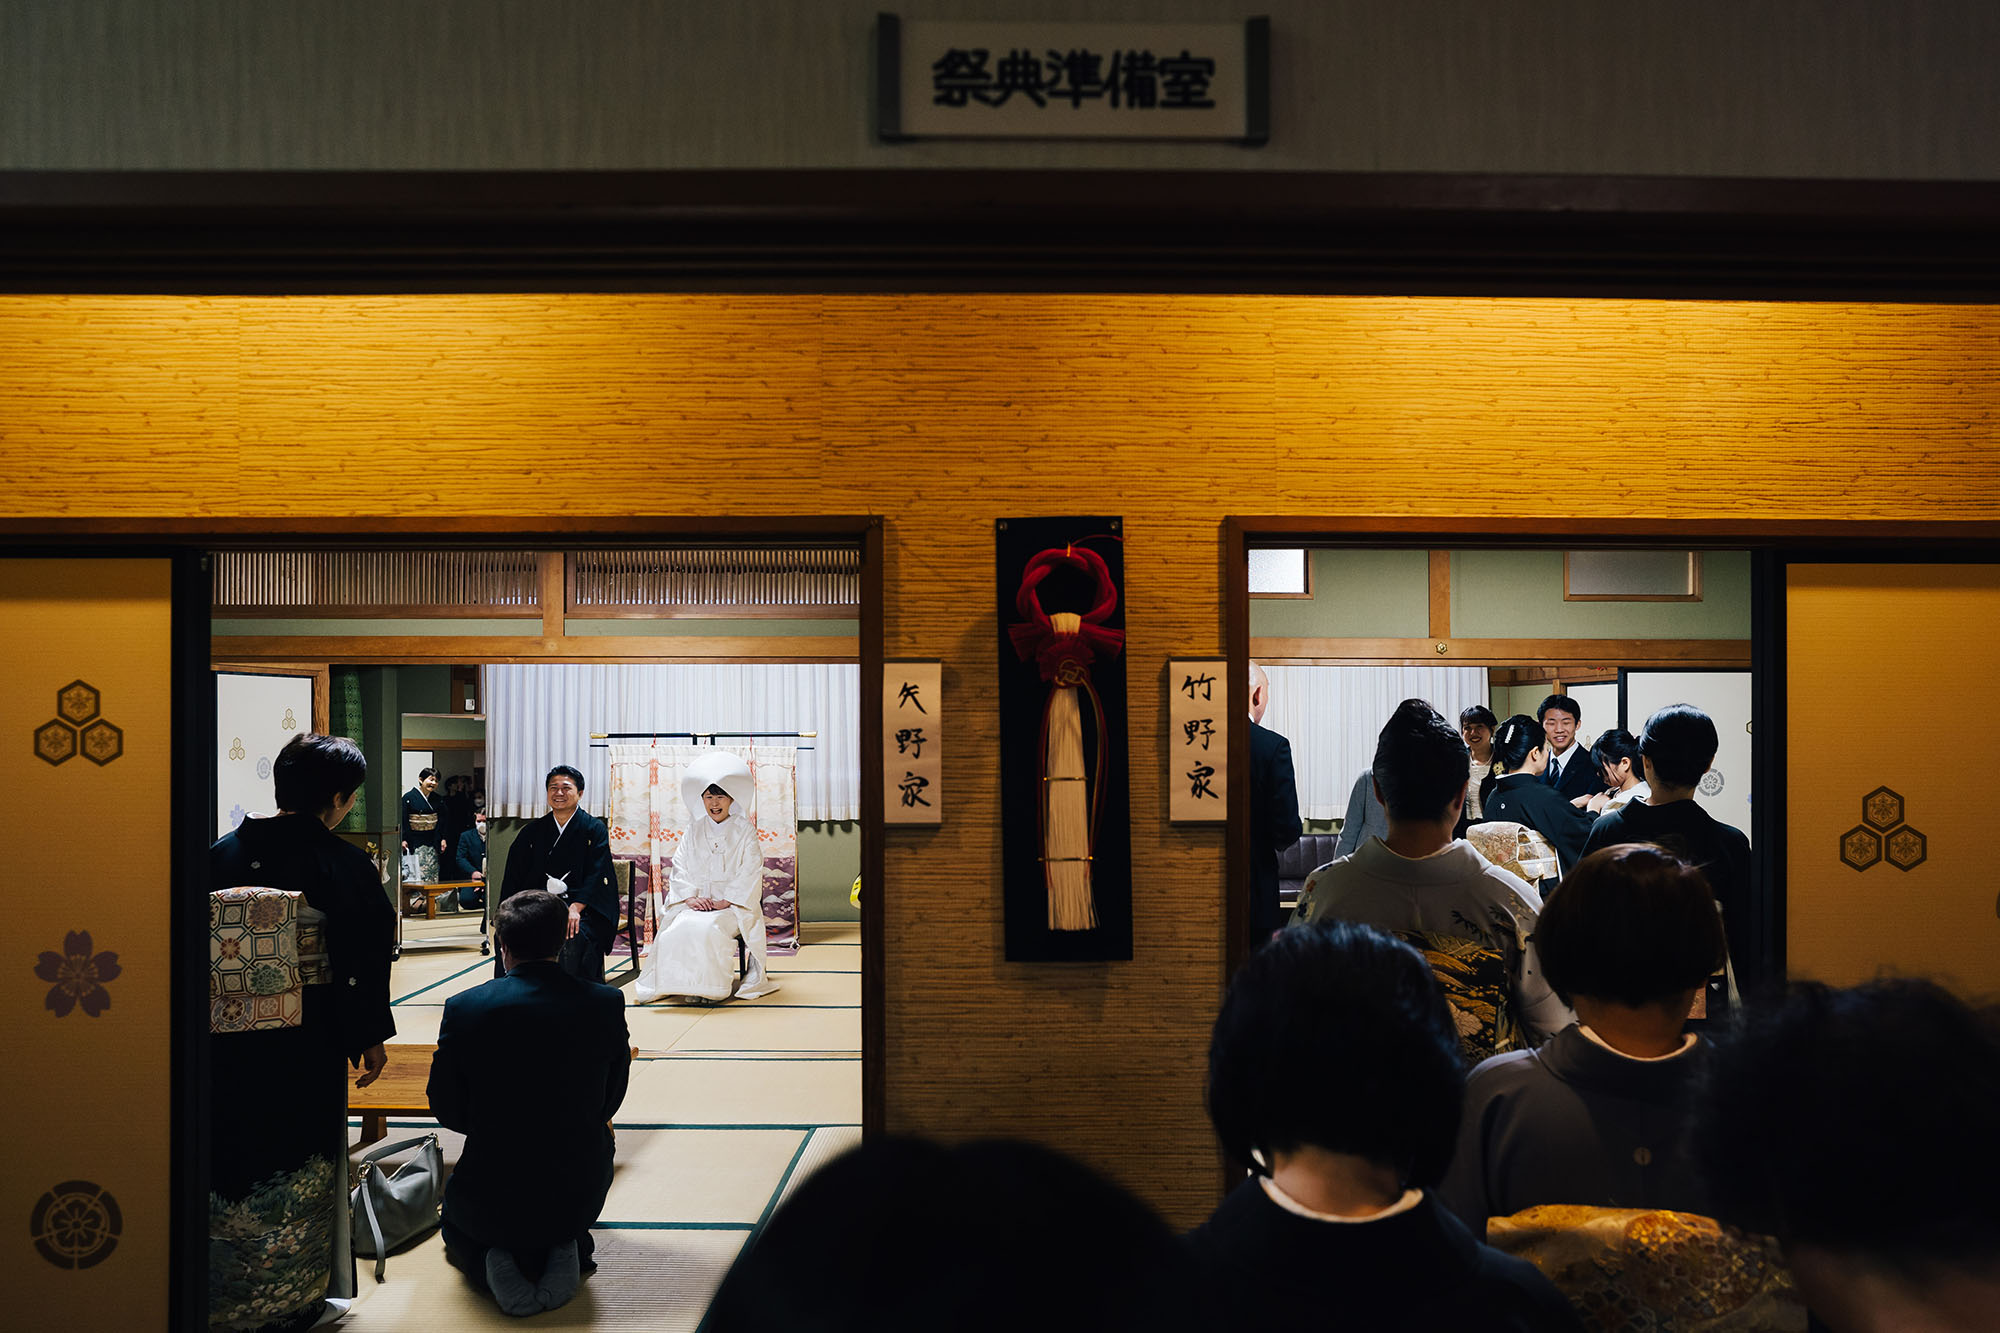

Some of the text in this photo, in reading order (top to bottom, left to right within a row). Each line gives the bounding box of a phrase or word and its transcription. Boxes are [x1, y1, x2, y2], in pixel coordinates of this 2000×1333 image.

[932, 48, 1215, 109] 祭典準備室
[895, 681, 931, 807] 矢野家
[1182, 673, 1219, 799] 竹野家
